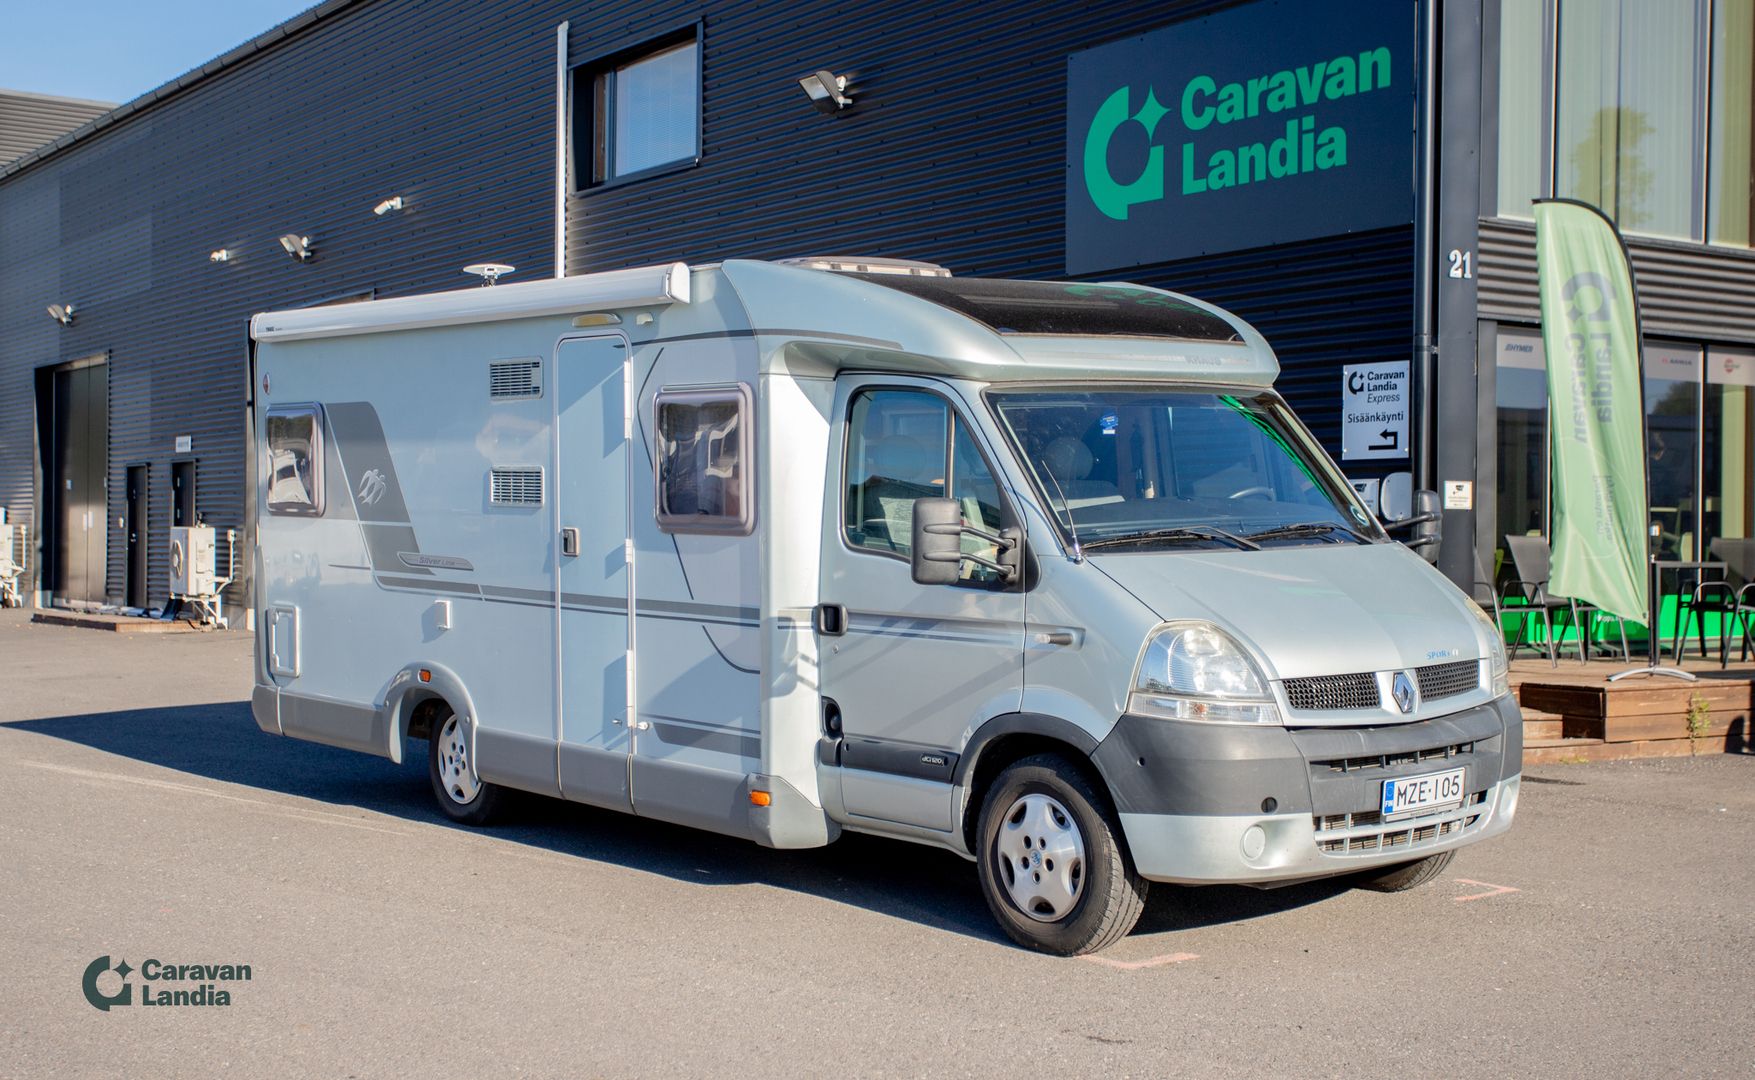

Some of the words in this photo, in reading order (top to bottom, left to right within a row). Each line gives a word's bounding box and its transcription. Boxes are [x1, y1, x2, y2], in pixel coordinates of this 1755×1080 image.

[1181, 46, 1391, 131] Caravan
[1182, 114, 1348, 195] Landia
[1449, 249, 1472, 279] 21
[1367, 370, 1405, 381] Caravan
[1367, 382, 1398, 392] Landia
[1367, 393, 1401, 404] Express
[1347, 411, 1404, 424] Sisäänkäynti
[1396, 775, 1460, 807] MZE-105
